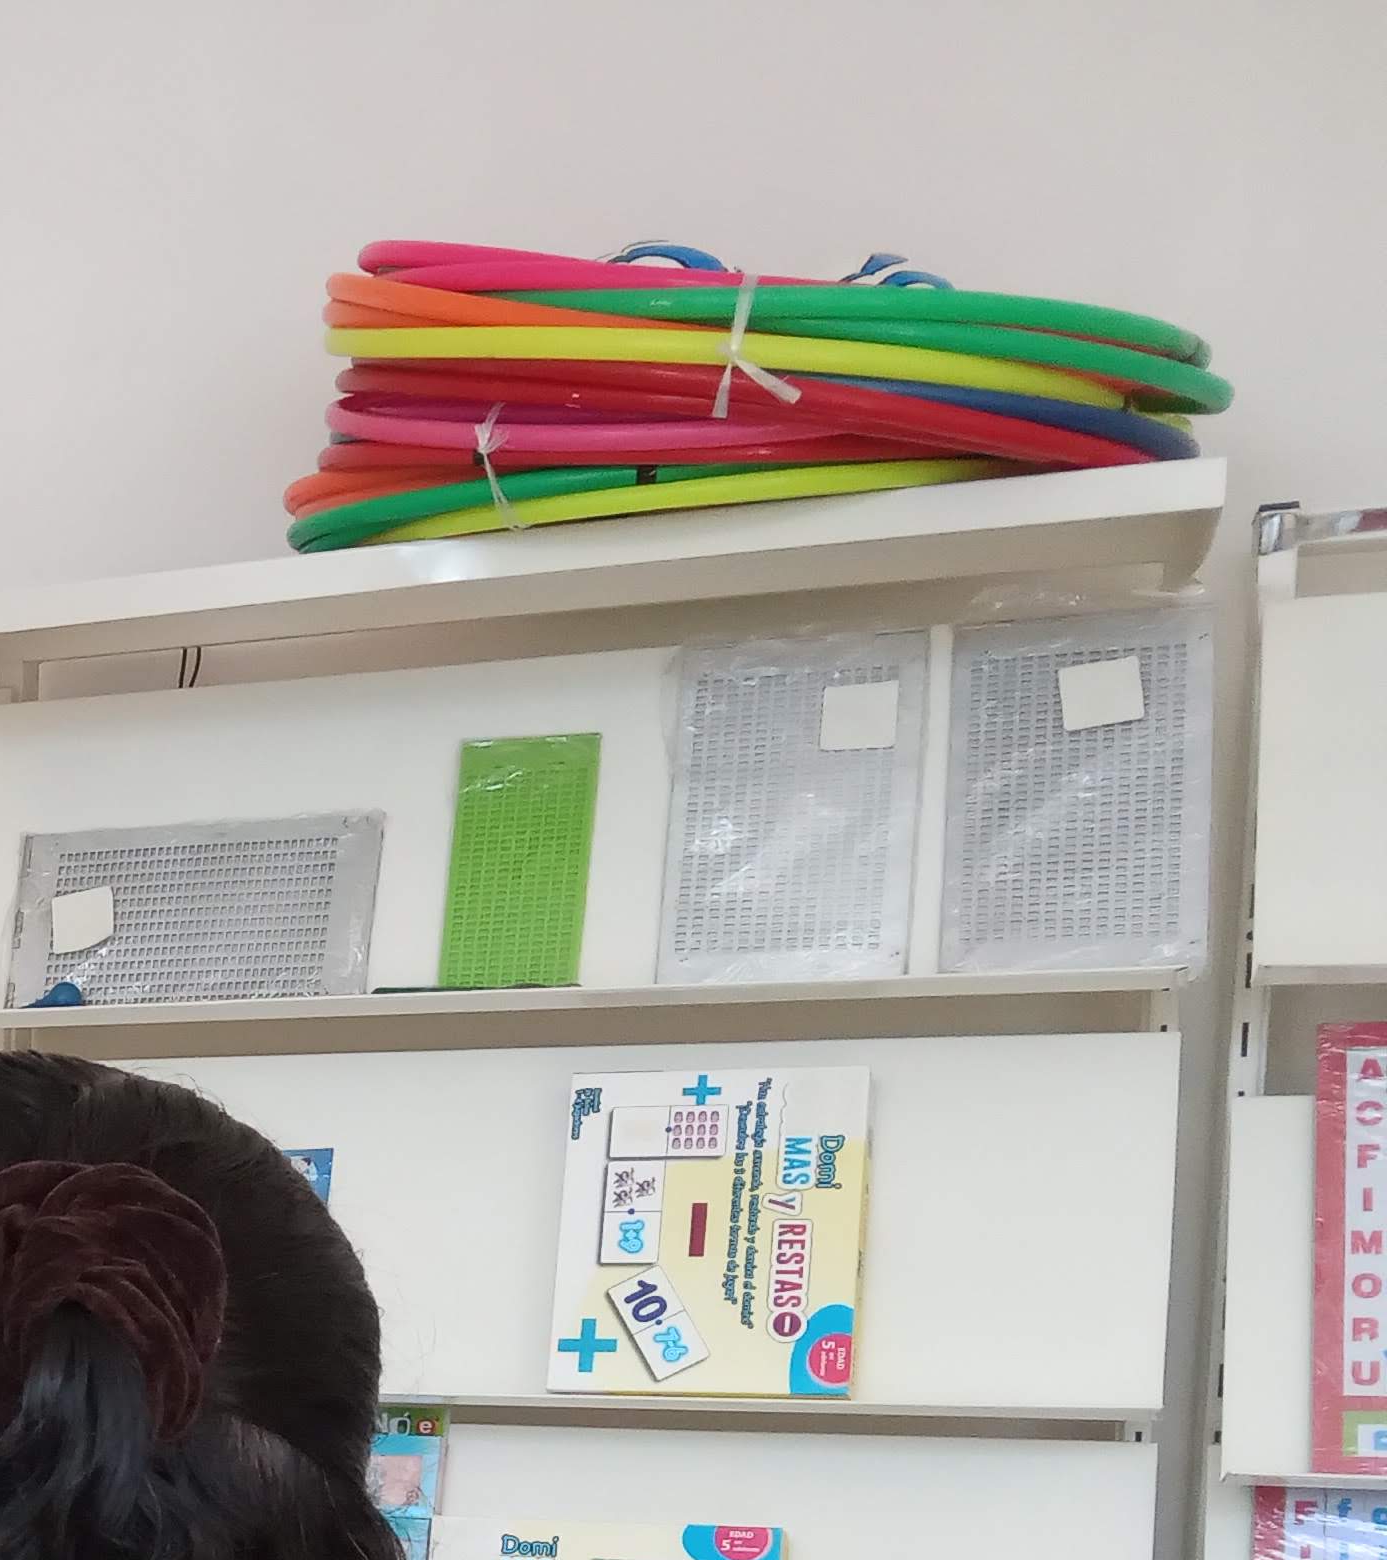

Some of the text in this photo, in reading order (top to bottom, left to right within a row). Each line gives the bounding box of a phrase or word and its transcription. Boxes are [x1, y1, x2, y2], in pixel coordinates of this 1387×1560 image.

[816, 1134, 847, 1190] Domi
[1356, 1144, 1381, 1169] F
[1362, 1187, 1373, 1212] I
[768, 1136, 812, 1308] MAS y RESTAS
[1350, 1230, 1383, 1255] M
[1351, 1273, 1383, 1300] O
[623, 1278, 668, 1323] 10
[1351, 1317, 1380, 1342] R
[821, 1339, 836, 1350] 5
[836, 1347, 846, 1370] EDAD
[1351, 1361, 1380, 1386] U
[501, 1534, 560, 1558] Domi
[720, 1538, 732, 1551] 5
[729, 1530, 755, 1539] EDAD
